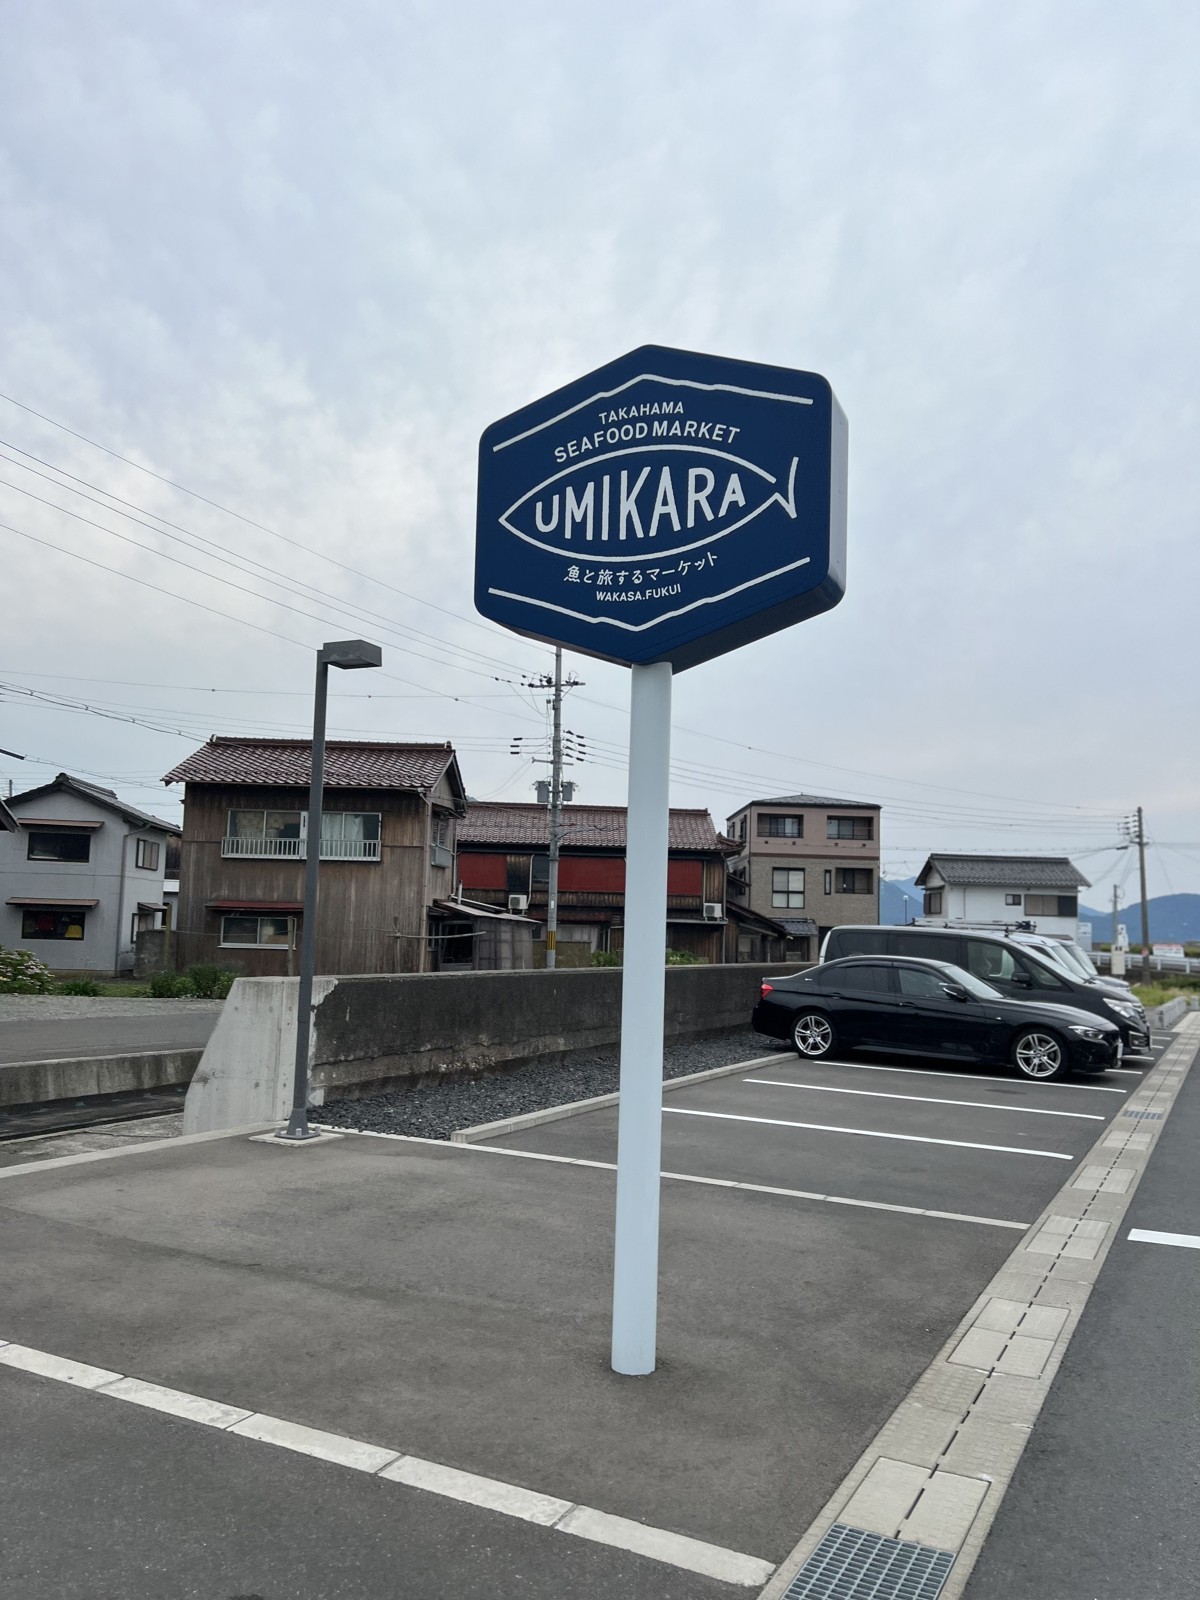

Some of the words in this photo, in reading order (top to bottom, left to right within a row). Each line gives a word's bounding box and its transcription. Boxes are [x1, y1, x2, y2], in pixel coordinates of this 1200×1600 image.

[598, 401, 685, 425] TAKAHAMA
[554, 422, 648, 463] SEAFOOD
[651, 420, 741, 444] MARKET
[535, 466, 746, 541] UMIKARA
[563, 551, 719, 586] 魚と旅するマーケット
